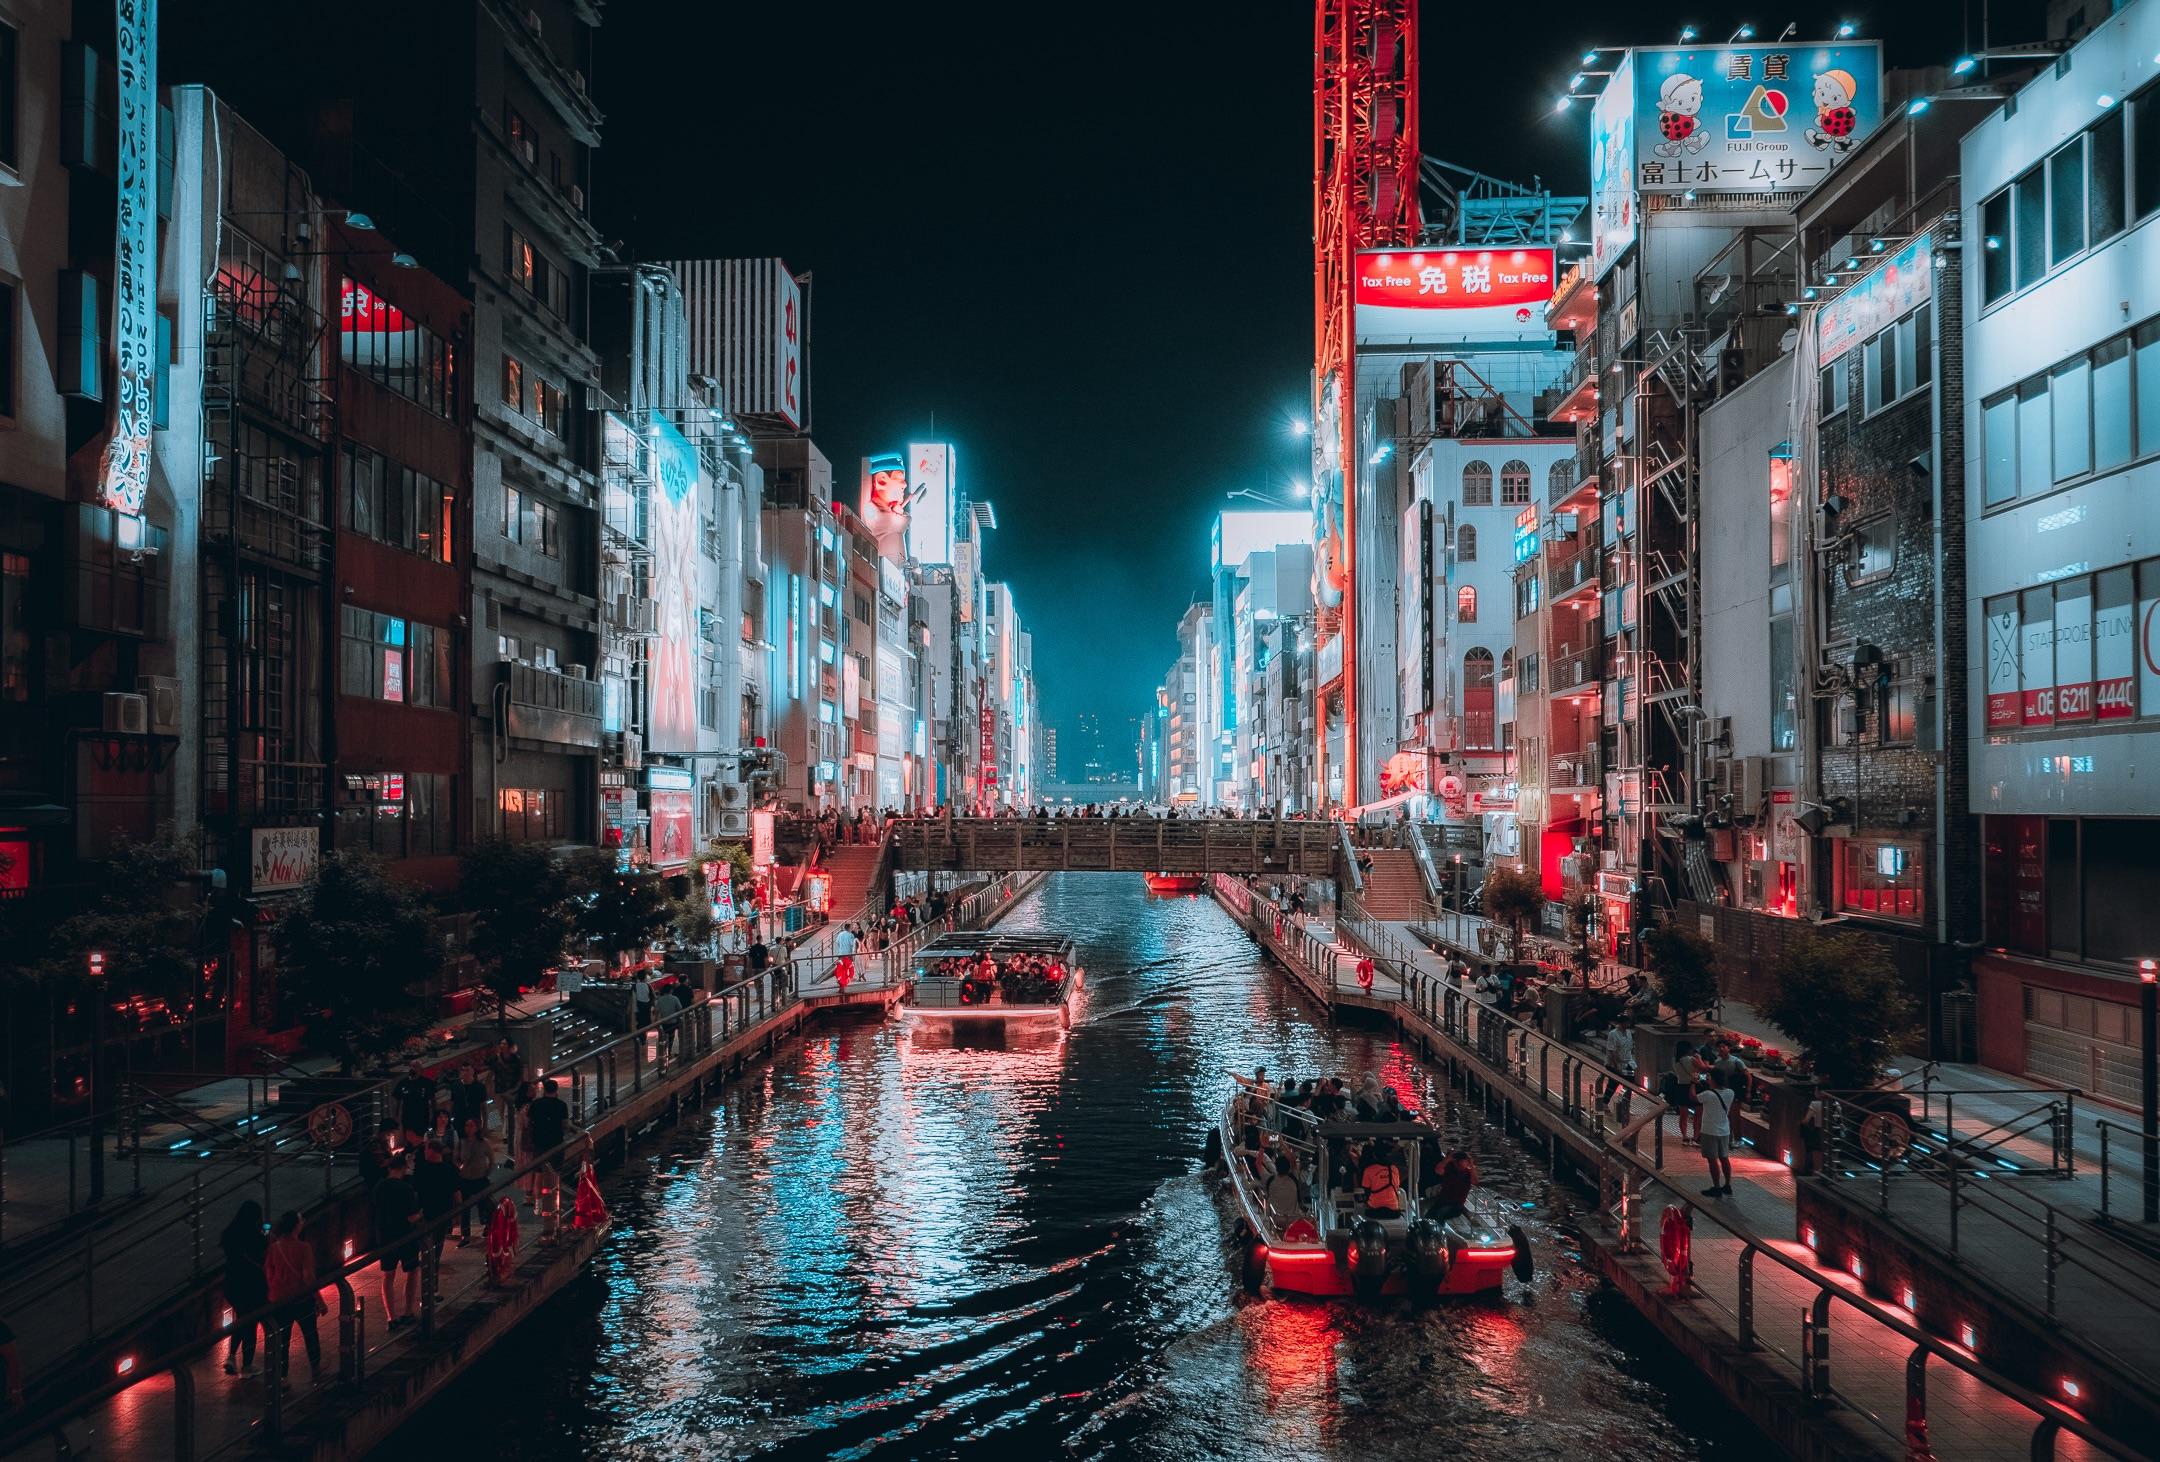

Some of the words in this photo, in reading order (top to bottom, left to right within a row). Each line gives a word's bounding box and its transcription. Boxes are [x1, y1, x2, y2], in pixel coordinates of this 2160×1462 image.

[1726, 54, 1791, 81] 賃貸
[138, 104, 147, 211] TEPPAN
[1727, 143, 1752, 152] FUJI
[1756, 143, 1788, 152] Group
[137, 221, 145, 254] TO
[137, 264, 145, 315] THE
[1362, 276, 1383, 288] Tax
[1386, 276, 1411, 287] Free
[1418, 265, 1492, 295] 免税
[1498, 272, 1519, 284] Tax
[1522, 271, 1548, 284] Free
[136, 323, 149, 437] WORLD'S
[2038, 690, 2054, 716] 06
[2060, 686, 2090, 714] 6211
